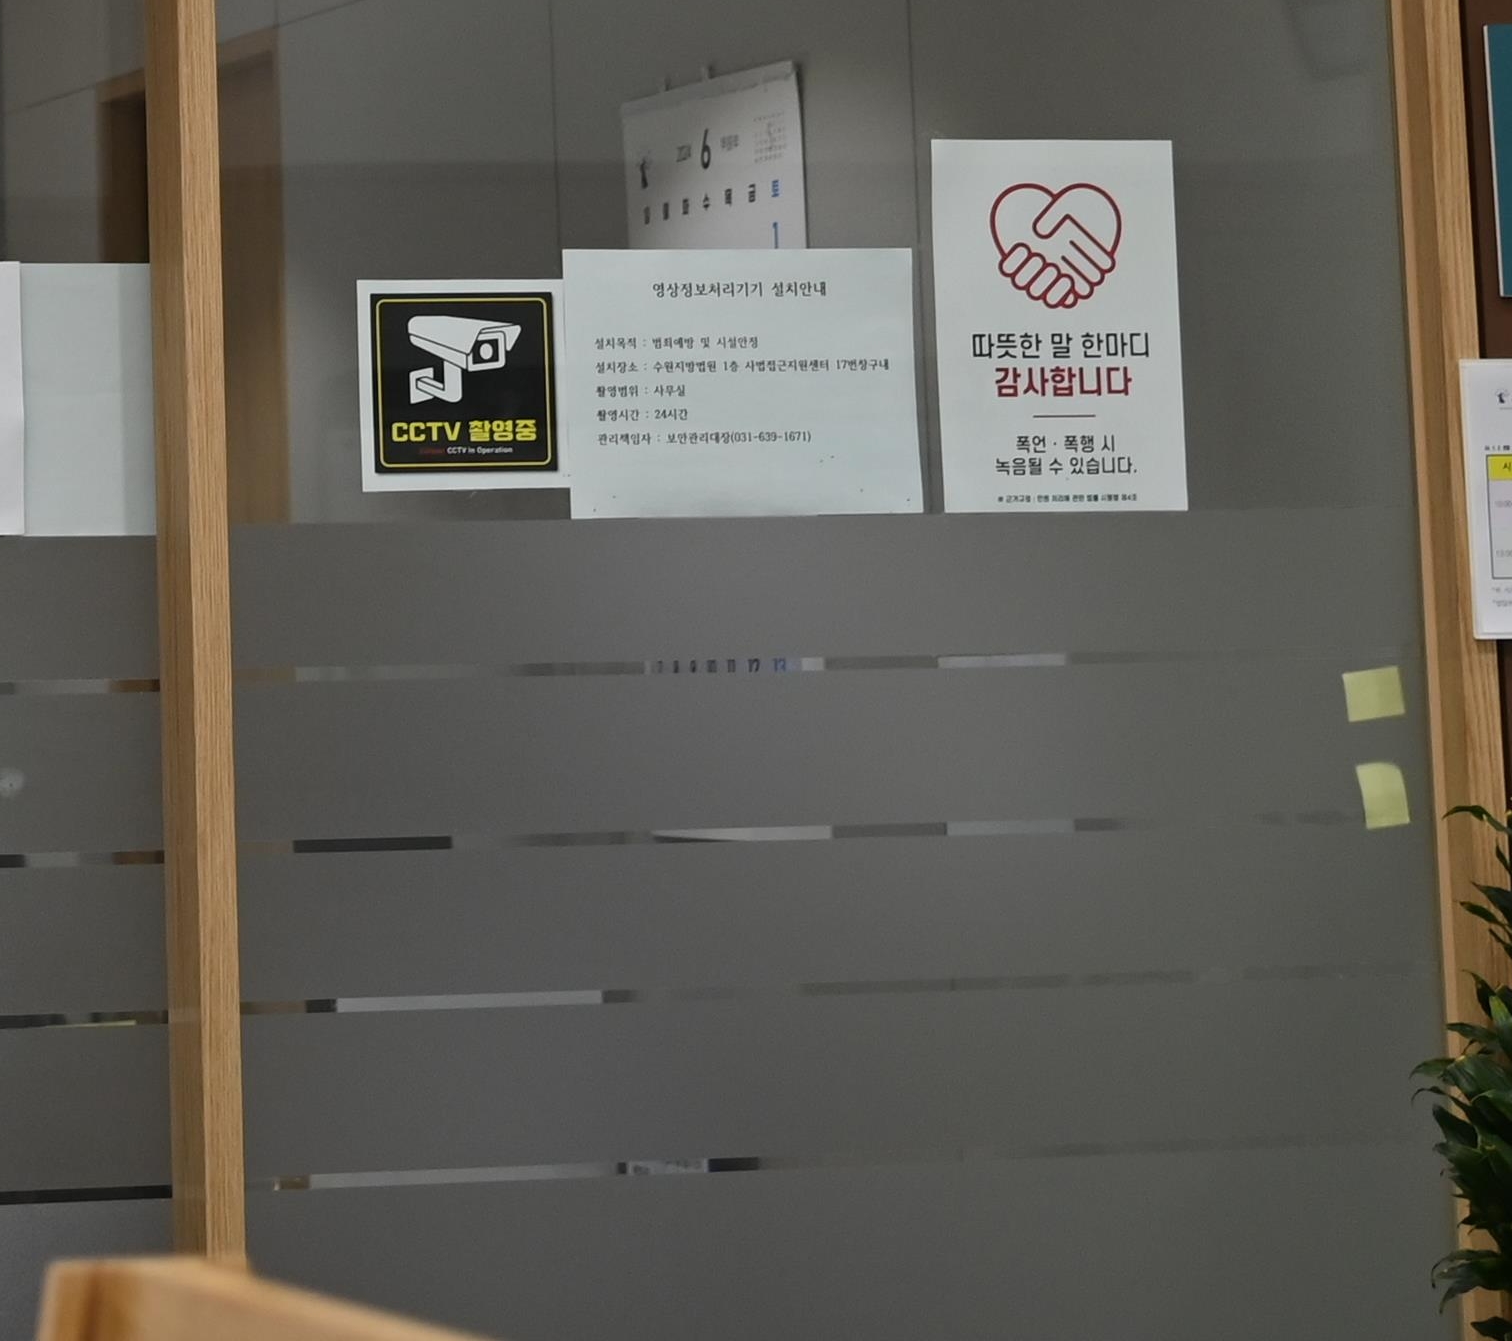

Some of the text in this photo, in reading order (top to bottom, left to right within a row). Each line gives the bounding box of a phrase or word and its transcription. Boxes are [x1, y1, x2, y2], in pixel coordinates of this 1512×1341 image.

[652, 281, 827, 298] 영상정보처리기기 설치안내
[595, 337, 637, 349] 설치목적
[973, 332, 1149, 359] 따뜻한 말 한마디
[595, 361, 638, 373] 설치장소
[653, 360, 717, 373] 수원지방법원
[745, 359, 829, 372] 사법접근지원센터
[995, 366, 1132, 397] 감사합니다
[654, 384, 685, 397] 사무실
[655, 408, 688, 421] 24시간
[392, 420, 536, 442] CCTV 촬영중
[1016, 435, 1115, 453] 폭언 폭행 시
[996, 457, 1137, 476] 녹음될 수 있습니다.
